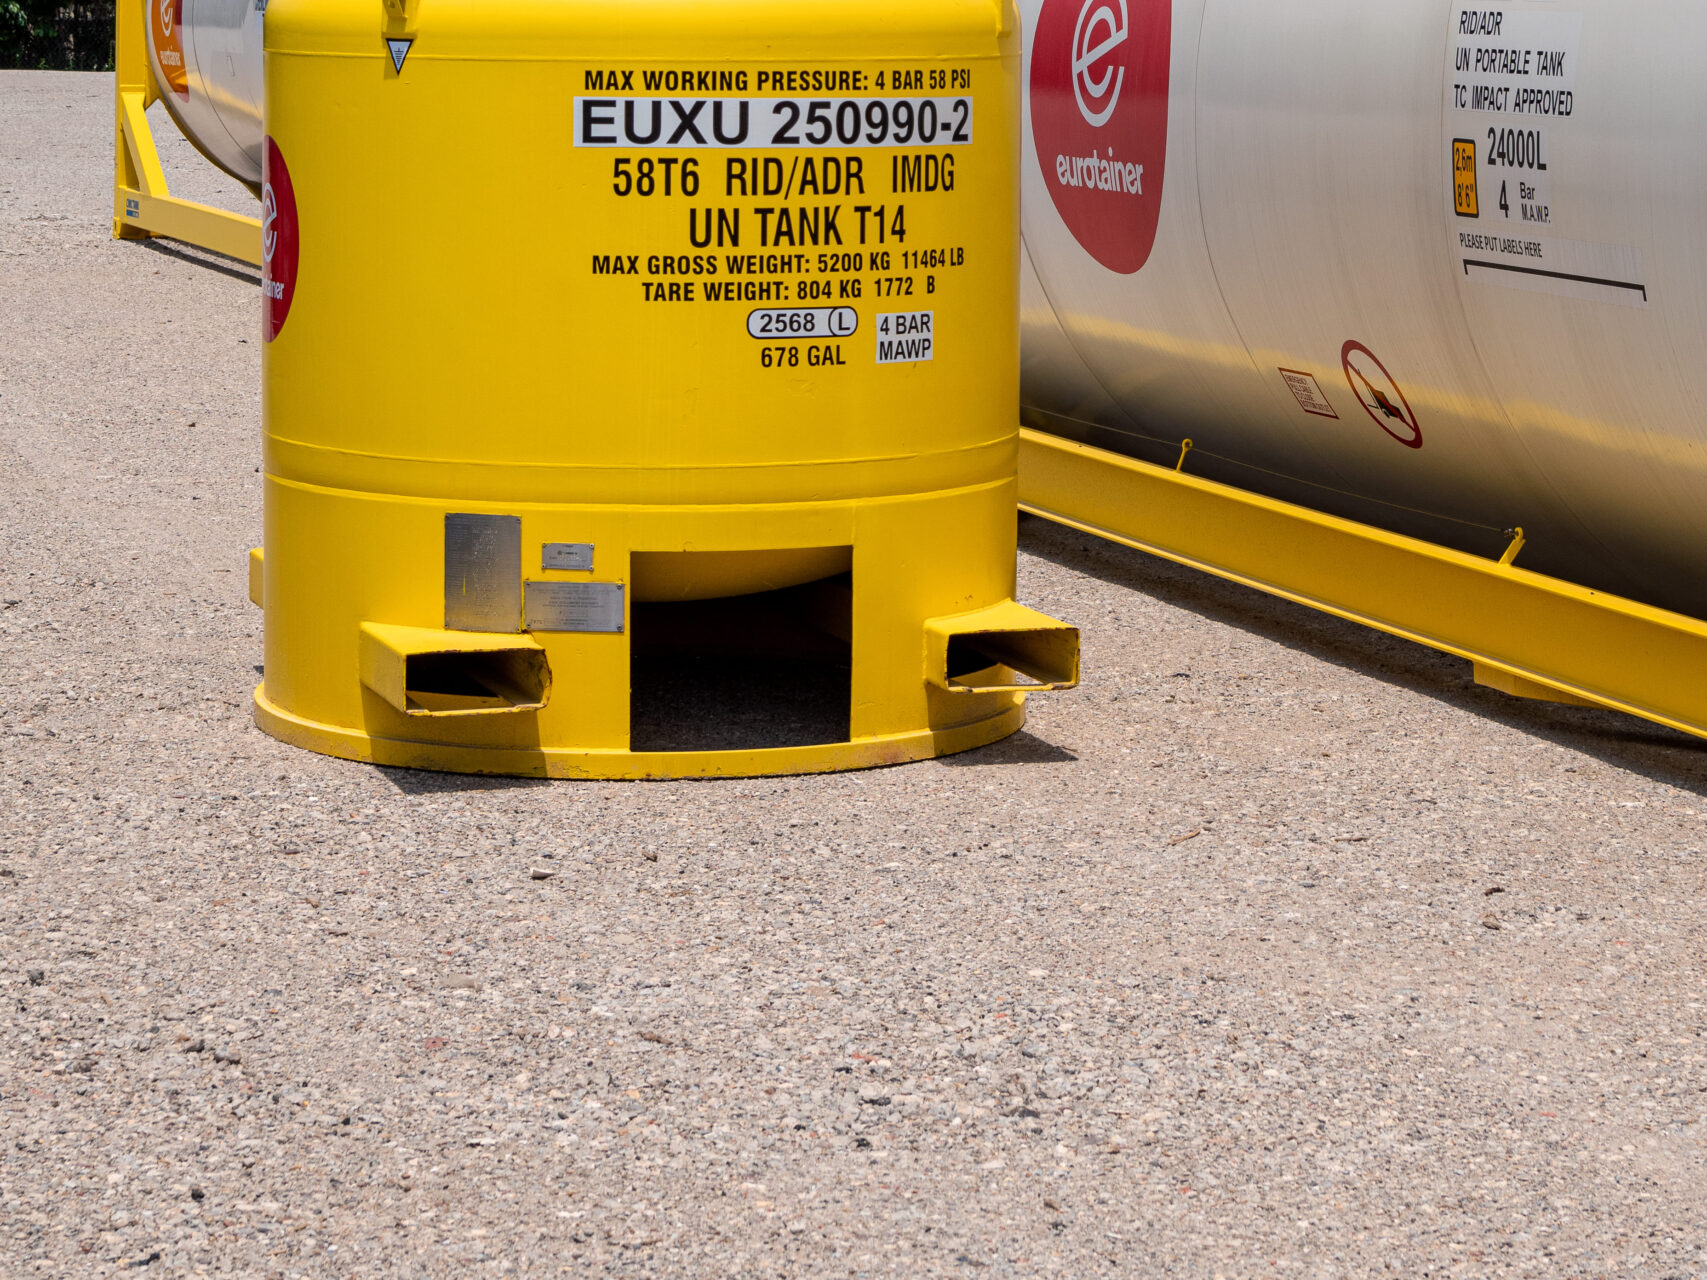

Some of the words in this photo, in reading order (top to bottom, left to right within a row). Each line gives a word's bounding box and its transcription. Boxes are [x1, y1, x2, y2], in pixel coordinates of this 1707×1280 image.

[1458, 10, 1503, 36] RID/ADR
[1455, 47, 1470, 72] UN
[1474, 48, 1530, 76] PORTABLE
[1536, 51, 1565, 77] TANK
[584, 70, 635, 91] MAX
[642, 70, 749, 91] WORKING
[756, 70, 869, 91] PRESSURE:
[875, 70, 885, 90] 4
[892, 69, 924, 90] BAR
[929, 69, 947, 89] 58
[951, 69, 971, 89] PSI
[1453, 84, 1467, 110] TC
[1471, 85, 1509, 113] IMPACT
[1513, 88, 1573, 117] APPROVED
[581, 99, 750, 145] EUXU
[770, 98, 970, 145] 250990-2
[1487, 126, 1547, 171] 24000L
[612, 157, 700, 197] 58T6
[725, 156, 865, 200] RID/ADR
[891, 153, 955, 194] IMDG
[1056, 146, 1144, 195] eurotainer
[1498, 179, 1510, 219] 4
[1519, 182, 1536, 202] Bar
[689, 207, 740, 248] UN
[754, 205, 843, 248] TANK
[854, 204, 906, 245] T14
[1459, 232, 1483, 250] PLEASE
[1484, 235, 1498, 253] PUT
[1498, 237, 1524, 257] LABELS
[1523, 239, 1543, 259] HERE
[592, 255, 639, 274] MAX
[647, 255, 717, 275] GROSS
[726, 253, 810, 274] WEIGHT:
[817, 252, 863, 272] 5200
[869, 251, 891, 271] KG
[902, 249, 946, 270] 11464
[950, 247, 964, 267] LB
[642, 282, 695, 302] TARE
[704, 281, 789, 301] WEIGHT:
[797, 280, 832, 300] 804
[839, 278, 862, 299] KG
[874, 277, 914, 297] 1772
[759, 312, 815, 333] 2568
[837, 311, 851, 331] L
[879, 316, 890, 335] 4
[895, 313, 931, 334] BAR
[760, 347, 799, 367] 678
[807, 345, 846, 367] GAL
[879, 338, 932, 361] MAWP
